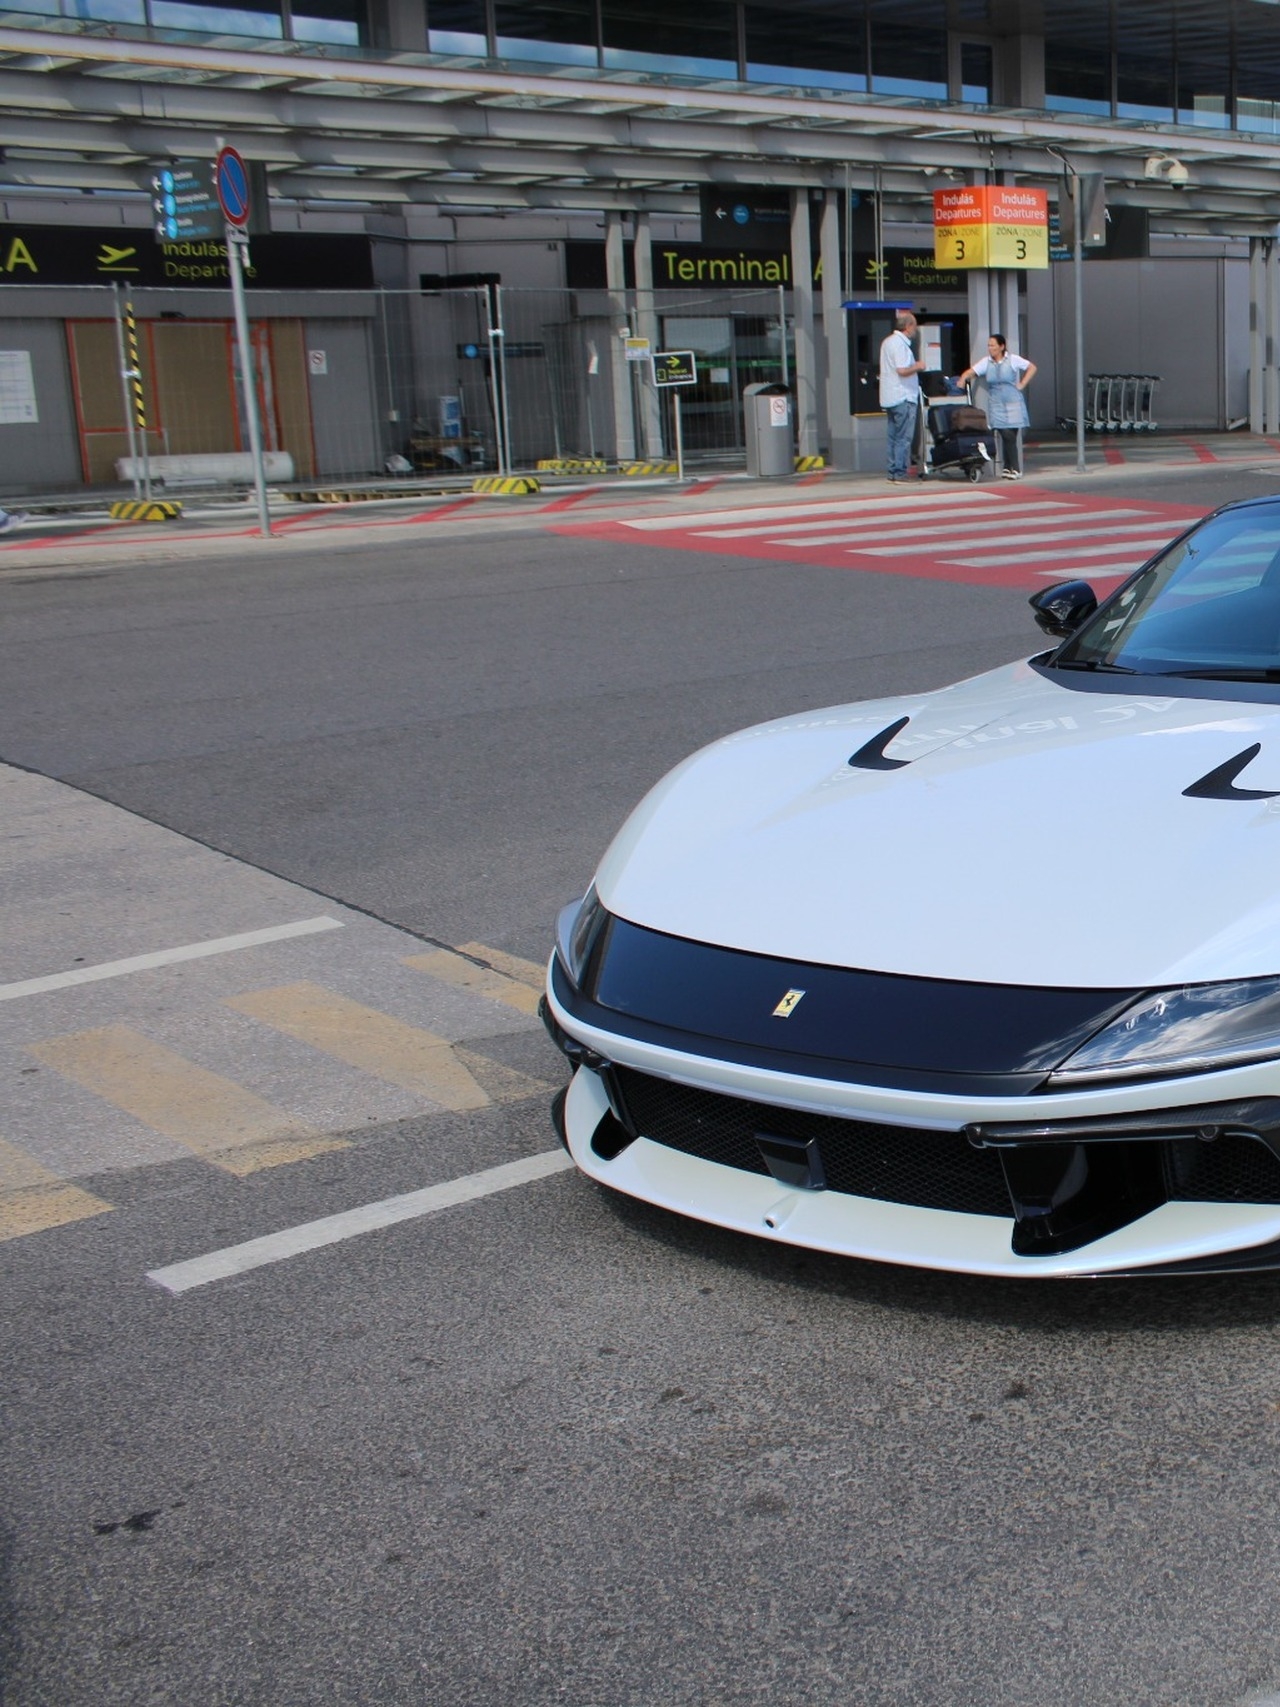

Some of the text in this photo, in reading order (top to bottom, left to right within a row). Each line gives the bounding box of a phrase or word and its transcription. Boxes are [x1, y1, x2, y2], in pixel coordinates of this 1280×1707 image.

[942, 193, 974, 206] Indulás
[1001, 193, 1037, 206] Indulás
[935, 208, 982, 221] Departures
[993, 206, 1045, 220] Departures
[955, 240, 965, 260] 3
[1016, 240, 1026, 260] 3
[663, 252, 788, 281] Terminal
[904, 272, 958, 285] Departure
